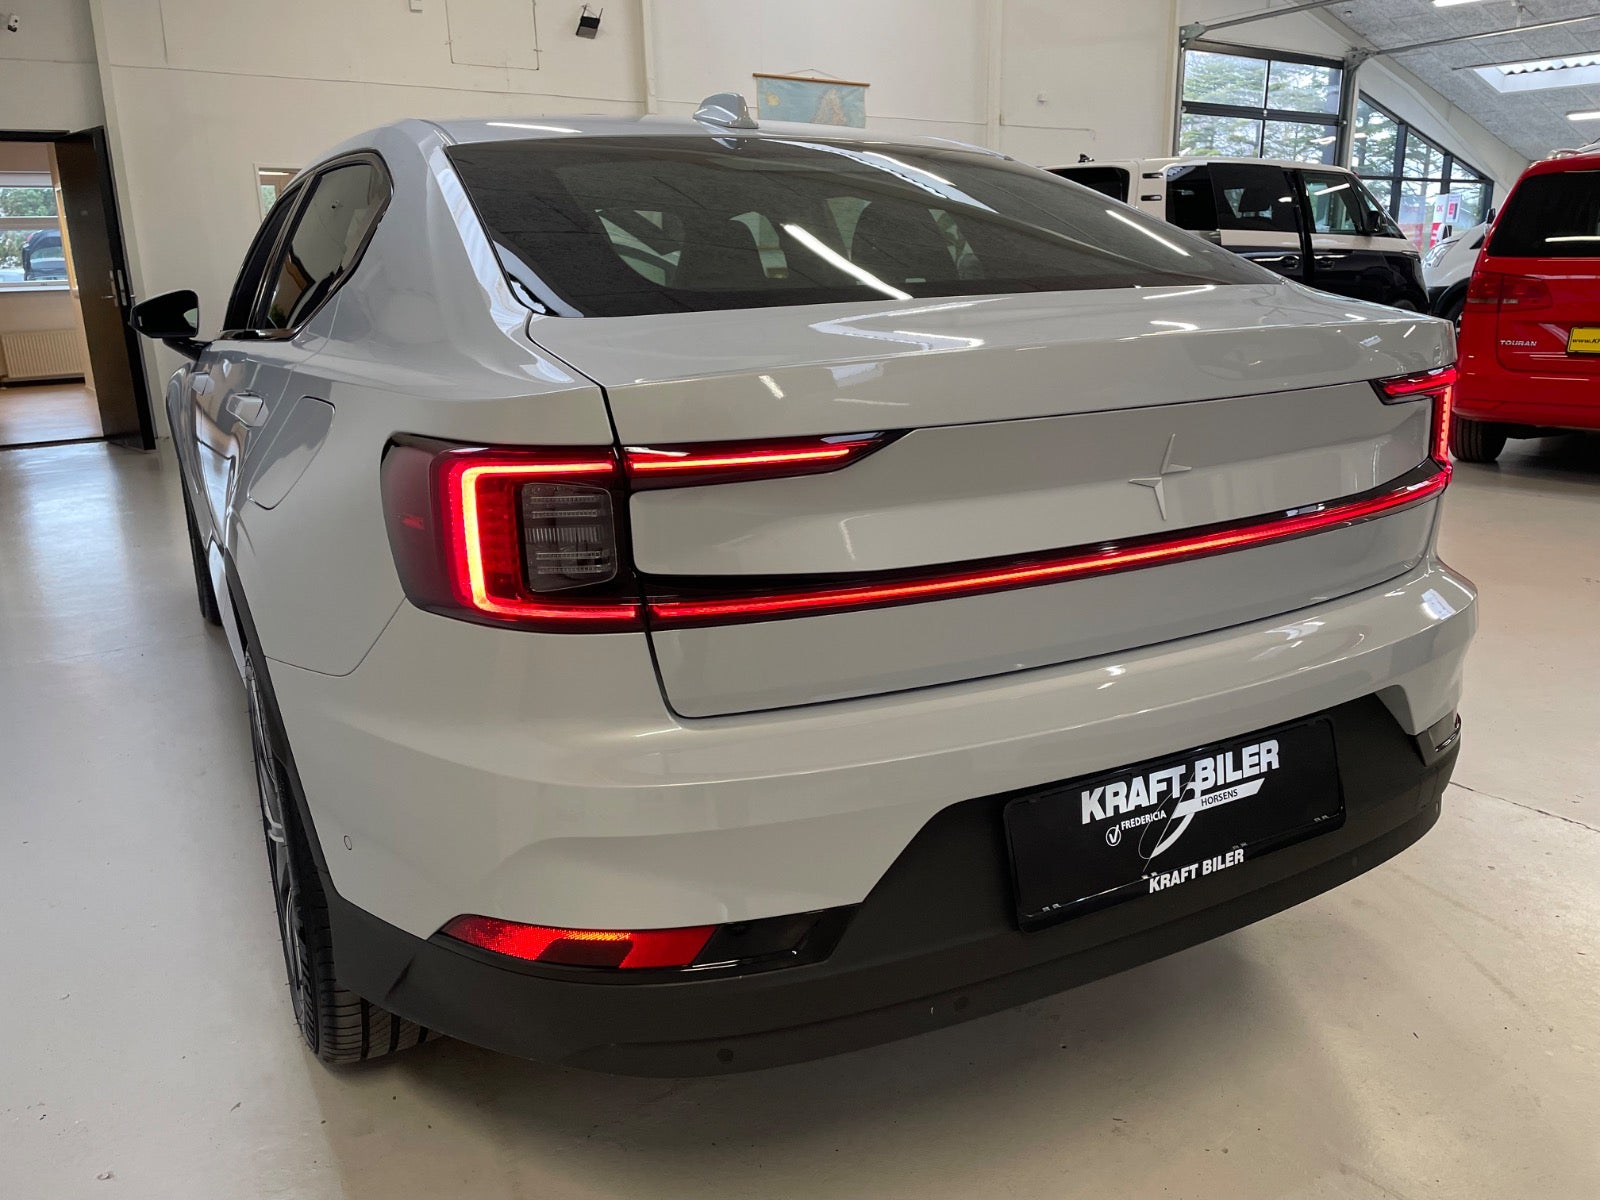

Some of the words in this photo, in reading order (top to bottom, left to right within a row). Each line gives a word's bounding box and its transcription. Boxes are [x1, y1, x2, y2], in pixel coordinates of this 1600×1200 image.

[1081, 764, 1186, 825] KRAFT
[1194, 739, 1280, 792] BILER
[1201, 788, 1239, 807] HORSENS
[1120, 809, 1168, 831] FREDERICIA
[1149, 863, 1199, 894] KRAFT
[1202, 848, 1244, 876] BILER
